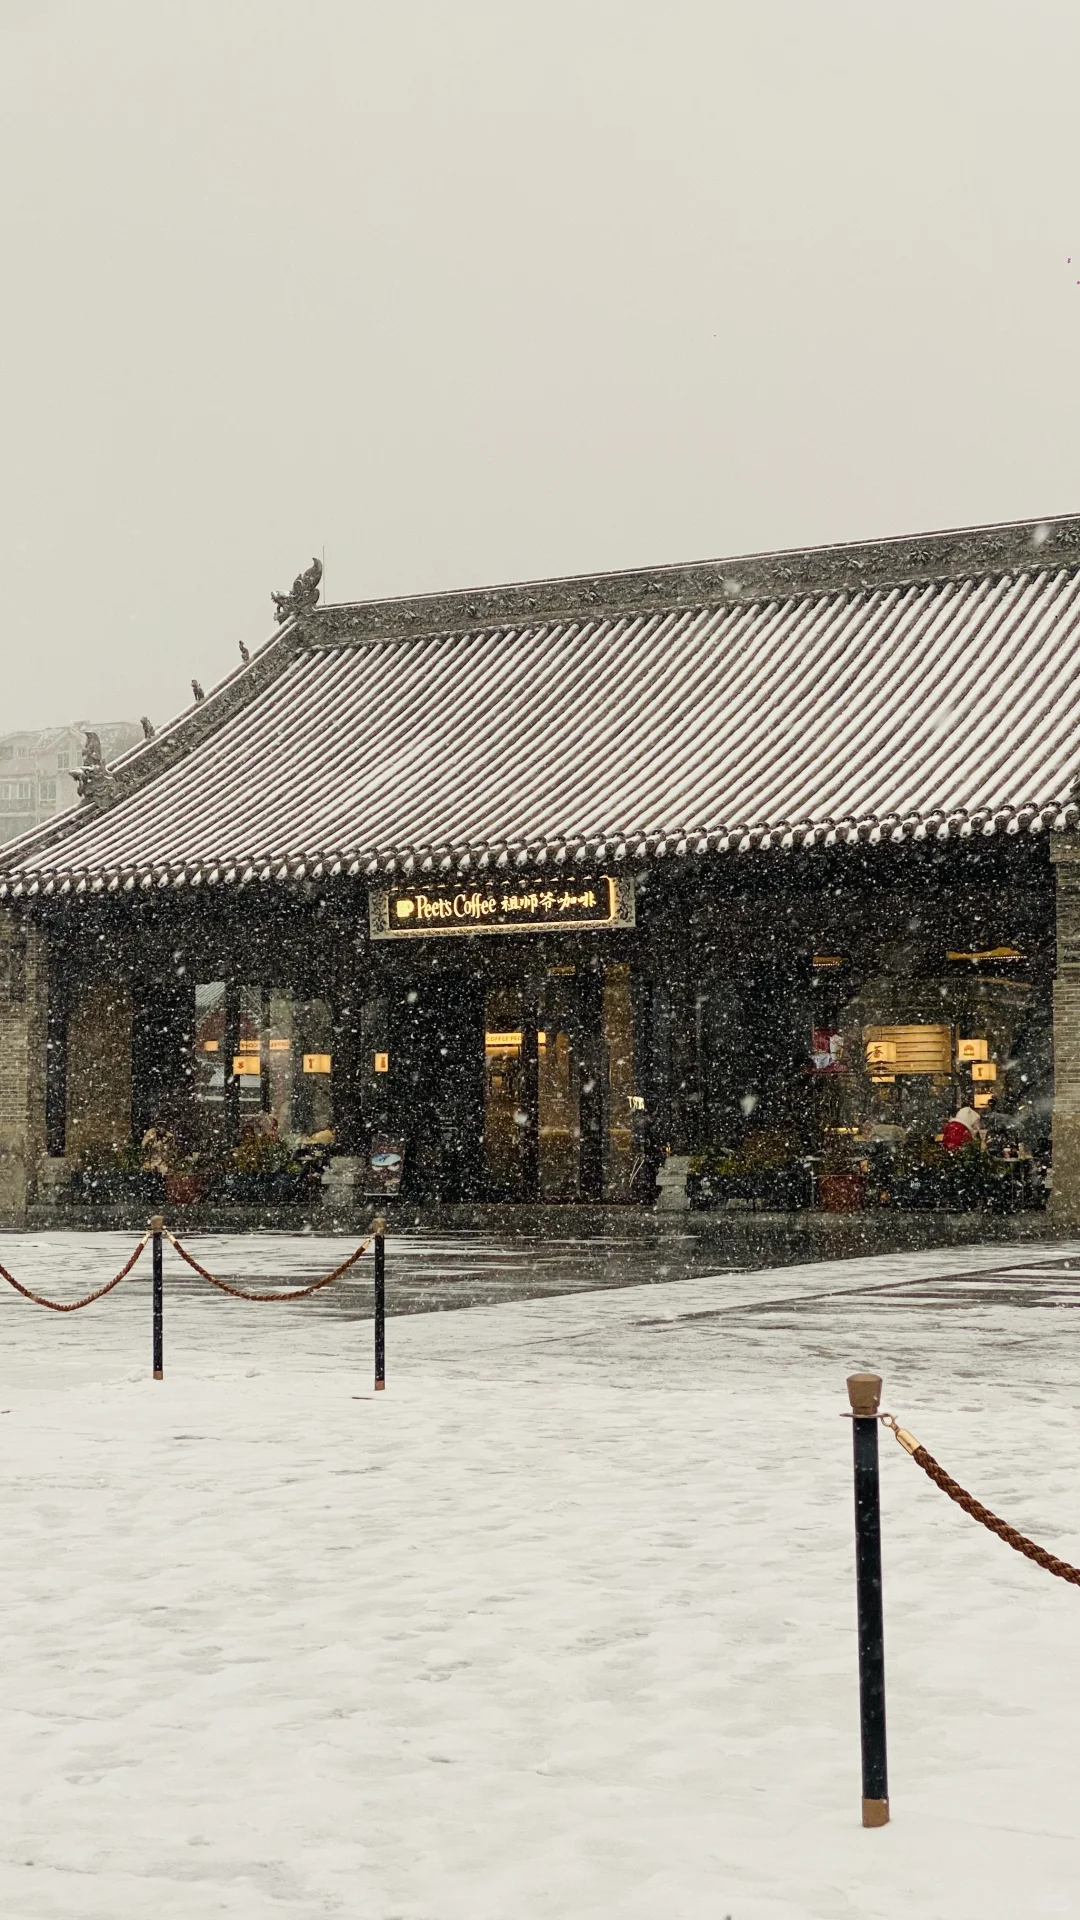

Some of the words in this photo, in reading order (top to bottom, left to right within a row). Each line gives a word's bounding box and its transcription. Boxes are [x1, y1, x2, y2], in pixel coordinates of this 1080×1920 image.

[415, 895, 453, 919] Peet's
[453, 893, 498, 918] Coffee
[500, 890, 597, 914] 祖师爷咖啡
